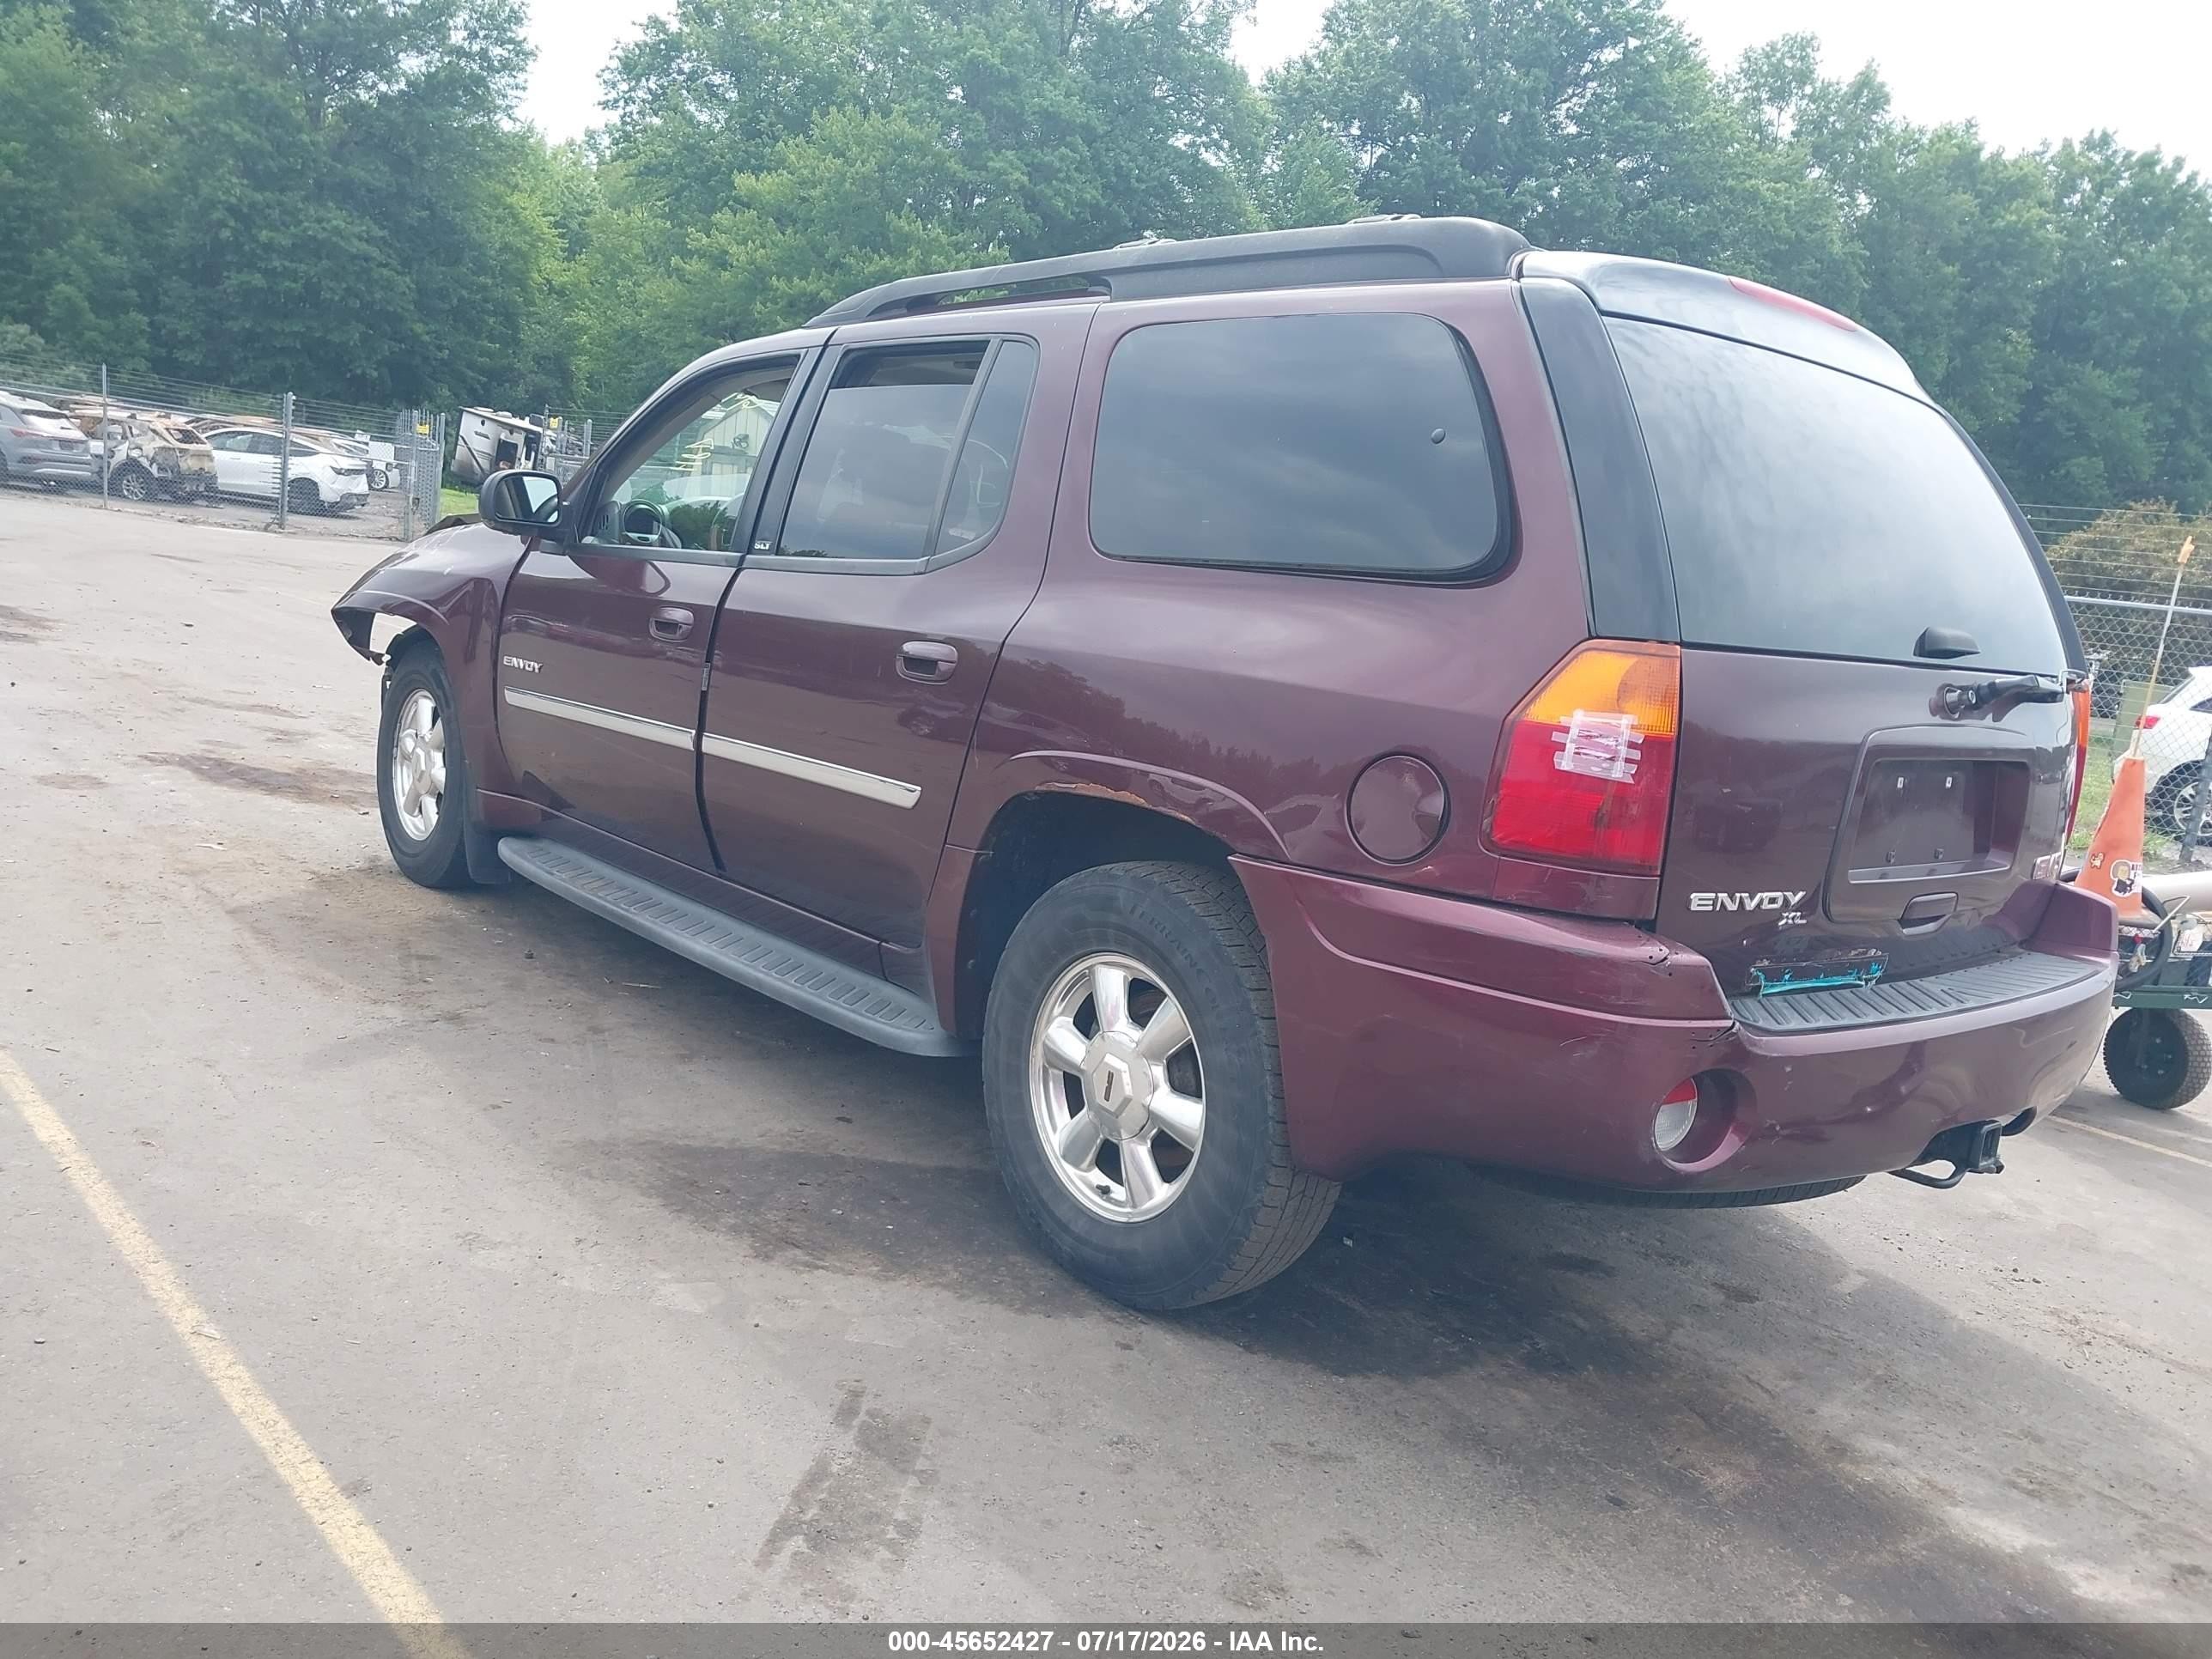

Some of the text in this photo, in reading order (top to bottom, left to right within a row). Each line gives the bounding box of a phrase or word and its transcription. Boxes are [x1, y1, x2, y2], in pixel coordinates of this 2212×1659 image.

[754, 541, 771, 550] SLT
[503, 655, 544, 674] ENVOY
[1689, 890, 1807, 911] ENVOY
[1778, 911, 1808, 926] XL
